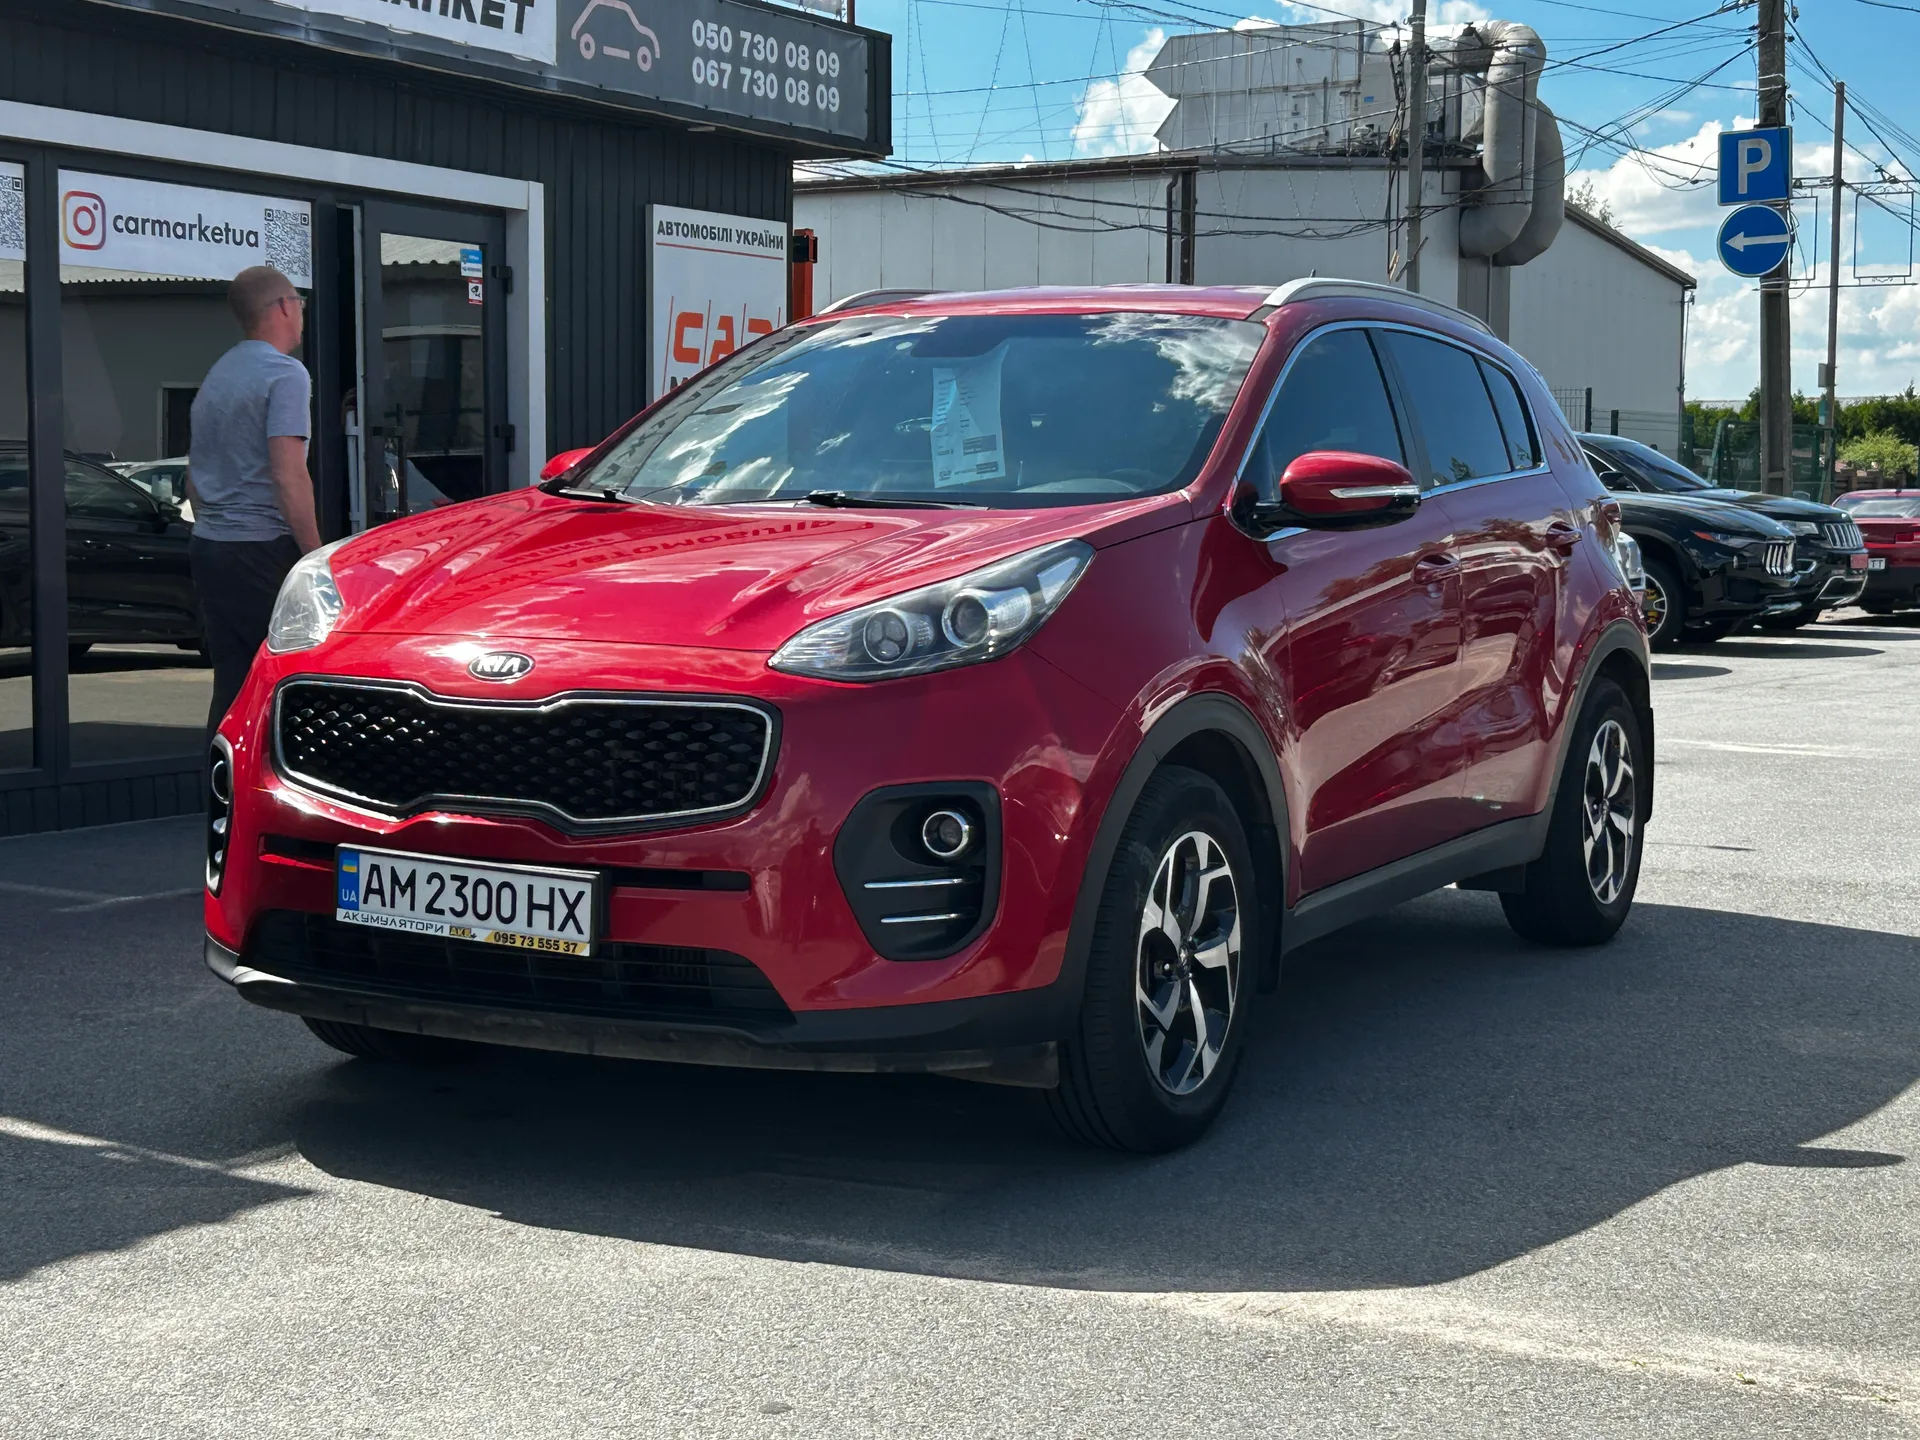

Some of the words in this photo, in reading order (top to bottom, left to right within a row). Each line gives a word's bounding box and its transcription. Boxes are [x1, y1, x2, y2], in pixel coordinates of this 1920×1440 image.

[692, 19, 732, 53] 050
[740, 30, 778, 64] 730
[785, 41, 810, 71] 08
[816, 49, 840, 78] 09
[692, 56, 732, 90] 067
[740, 66, 778, 99] 730
[785, 77, 810, 106] 08
[816, 84, 840, 113] 09
[1738, 138, 1772, 194] P
[113, 213, 259, 248] carmarketua
[657, 220, 733, 243] АВТОМОБІЛІ
[735, 229, 784, 250] УКРАЇНИ
[477, 656, 521, 672] KIA
[342, 888, 357, 903] UA
[362, 863, 417, 912] AM
[424, 871, 517, 925] 2300
[526, 884, 586, 935] HX
[343, 911, 444, 934] АКУМУЛЯТОРИ
[494, 931, 516, 945] 095
[520, 935, 534, 947] 73
[538, 938, 560, 950] 555
[563, 942, 578, 953] 37
